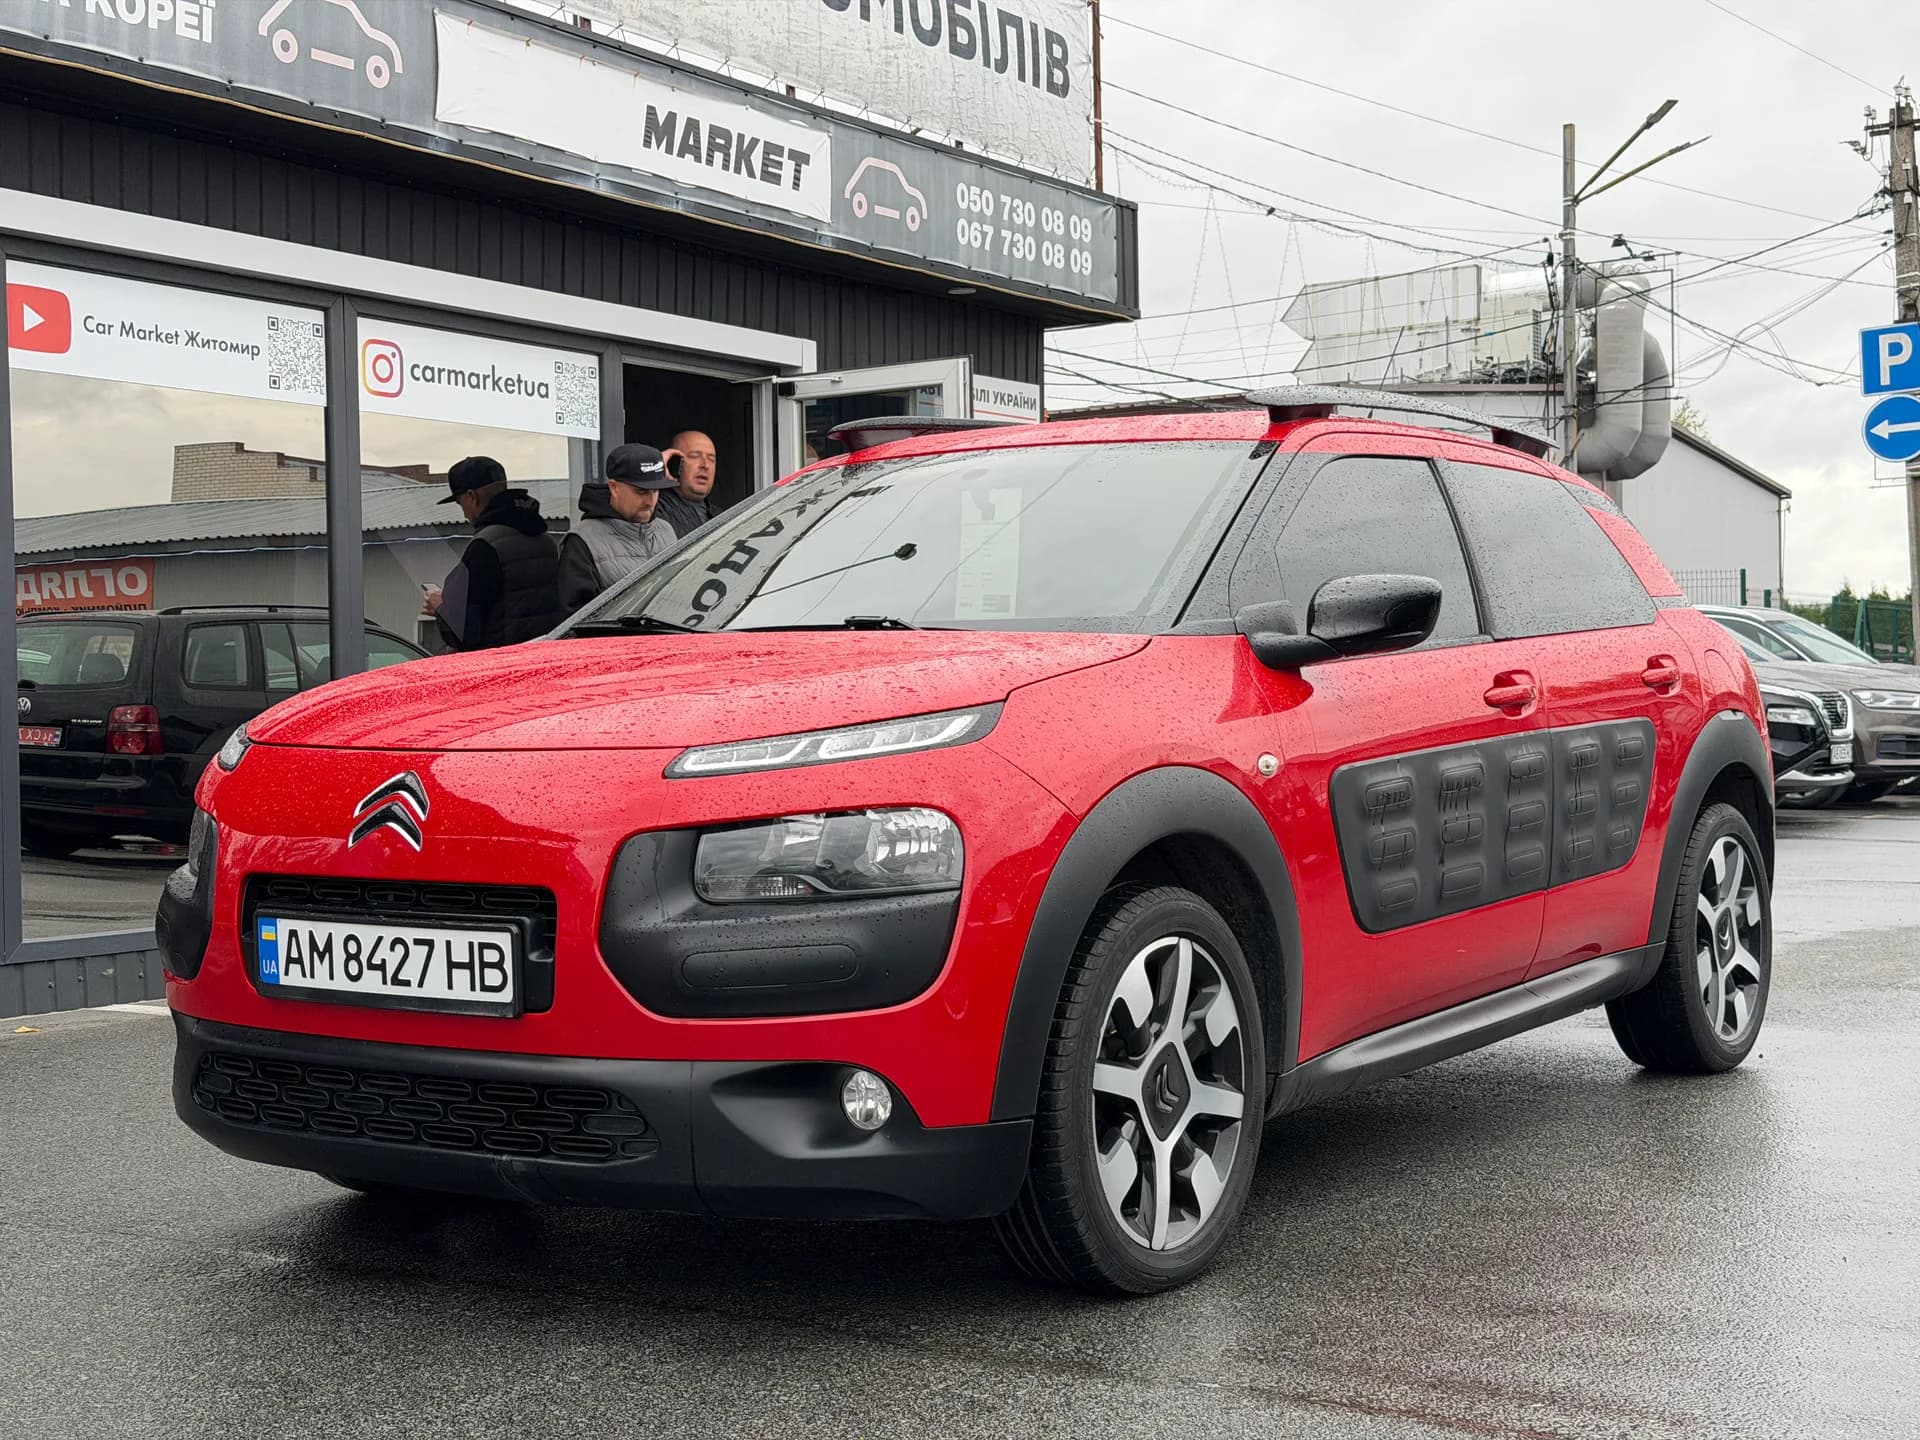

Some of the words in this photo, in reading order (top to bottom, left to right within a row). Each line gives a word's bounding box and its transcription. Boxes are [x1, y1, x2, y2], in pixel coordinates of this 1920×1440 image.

[821, 0, 1070, 99] ОБІЛІВ
[642, 103, 811, 192] MARKET
[956, 182, 994, 216] 050
[1000, 194, 1036, 228] 730
[1041, 206, 1065, 236] 08
[1069, 214, 1092, 243] 09
[956, 217, 994, 251] 067
[1001, 229, 1036, 262] 730
[1041, 240, 1065, 269] 08
[1070, 248, 1092, 276] 09
[83, 315, 114, 336] Car
[119, 320, 180, 345] Market
[184, 329, 261, 361] Житомир
[1878, 333, 1913, 387] P
[410, 363, 550, 399] carmarketua
[993, 390, 1037, 412] УКРАЇНИ
[263, 960, 277, 975] UA
[284, 928, 335, 981] AM
[343, 933, 435, 989] 8427
[445, 939, 508, 993] HB
